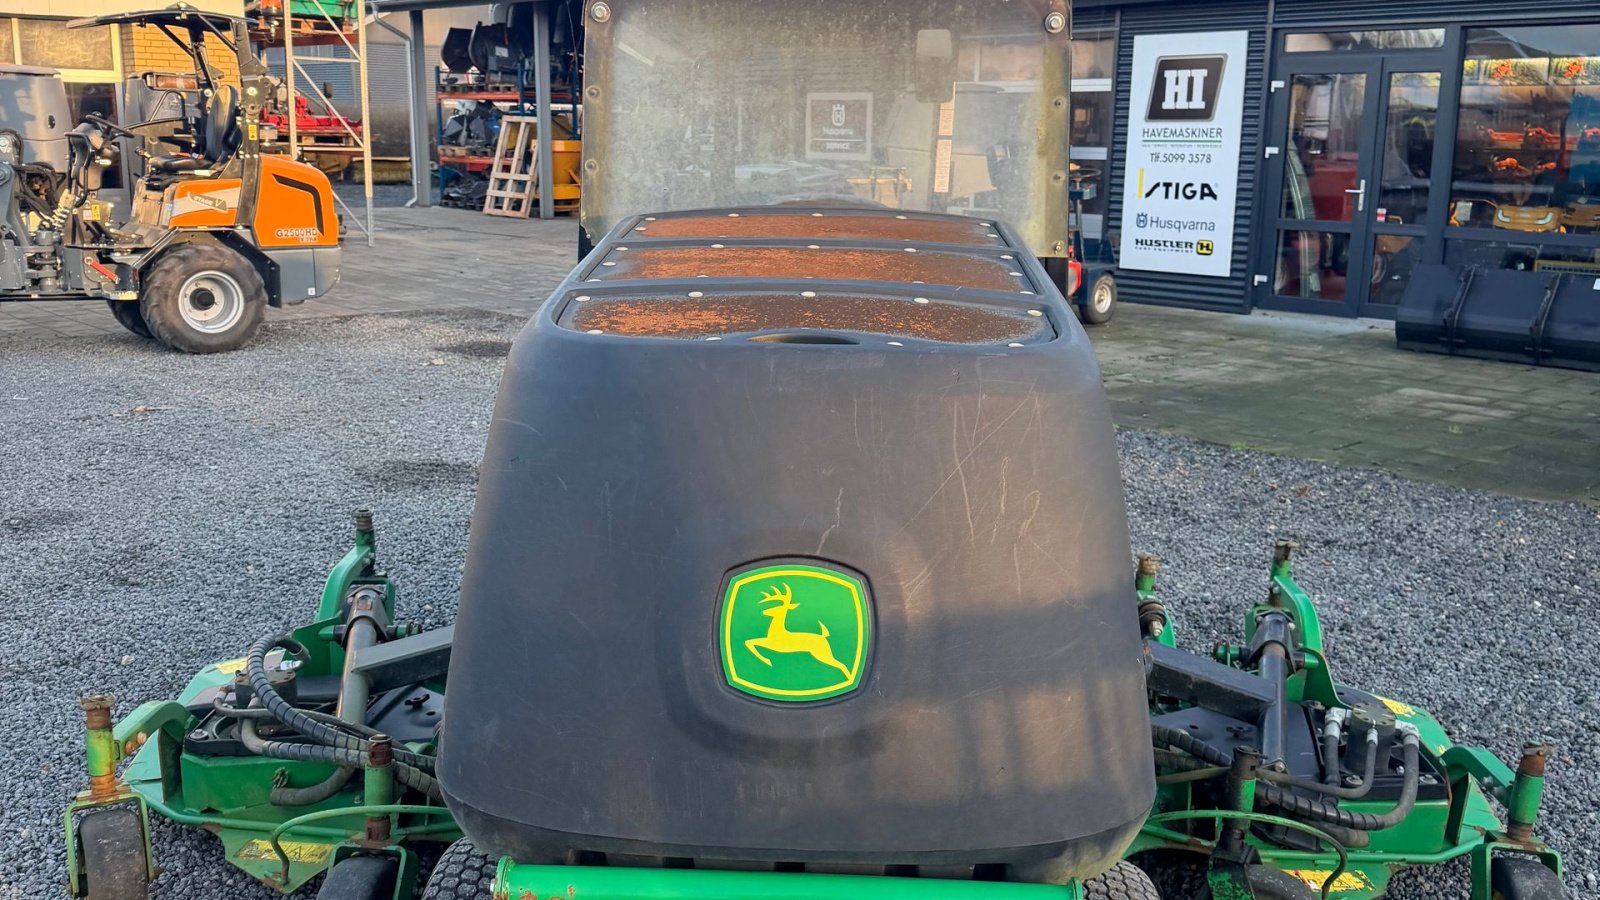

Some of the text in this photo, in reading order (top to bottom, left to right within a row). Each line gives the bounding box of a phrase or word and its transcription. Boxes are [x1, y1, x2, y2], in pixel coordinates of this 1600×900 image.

[1161, 69, 1208, 110] HI
[1142, 127, 1223, 138] HAVEMASKINER
[1150, 153, 1212, 164] Tlf.5099 3578
[1145, 182, 1218, 201] STIGA
[1150, 216, 1216, 233] Husqvarna
[1135, 238, 1194, 249] HUSTLER
